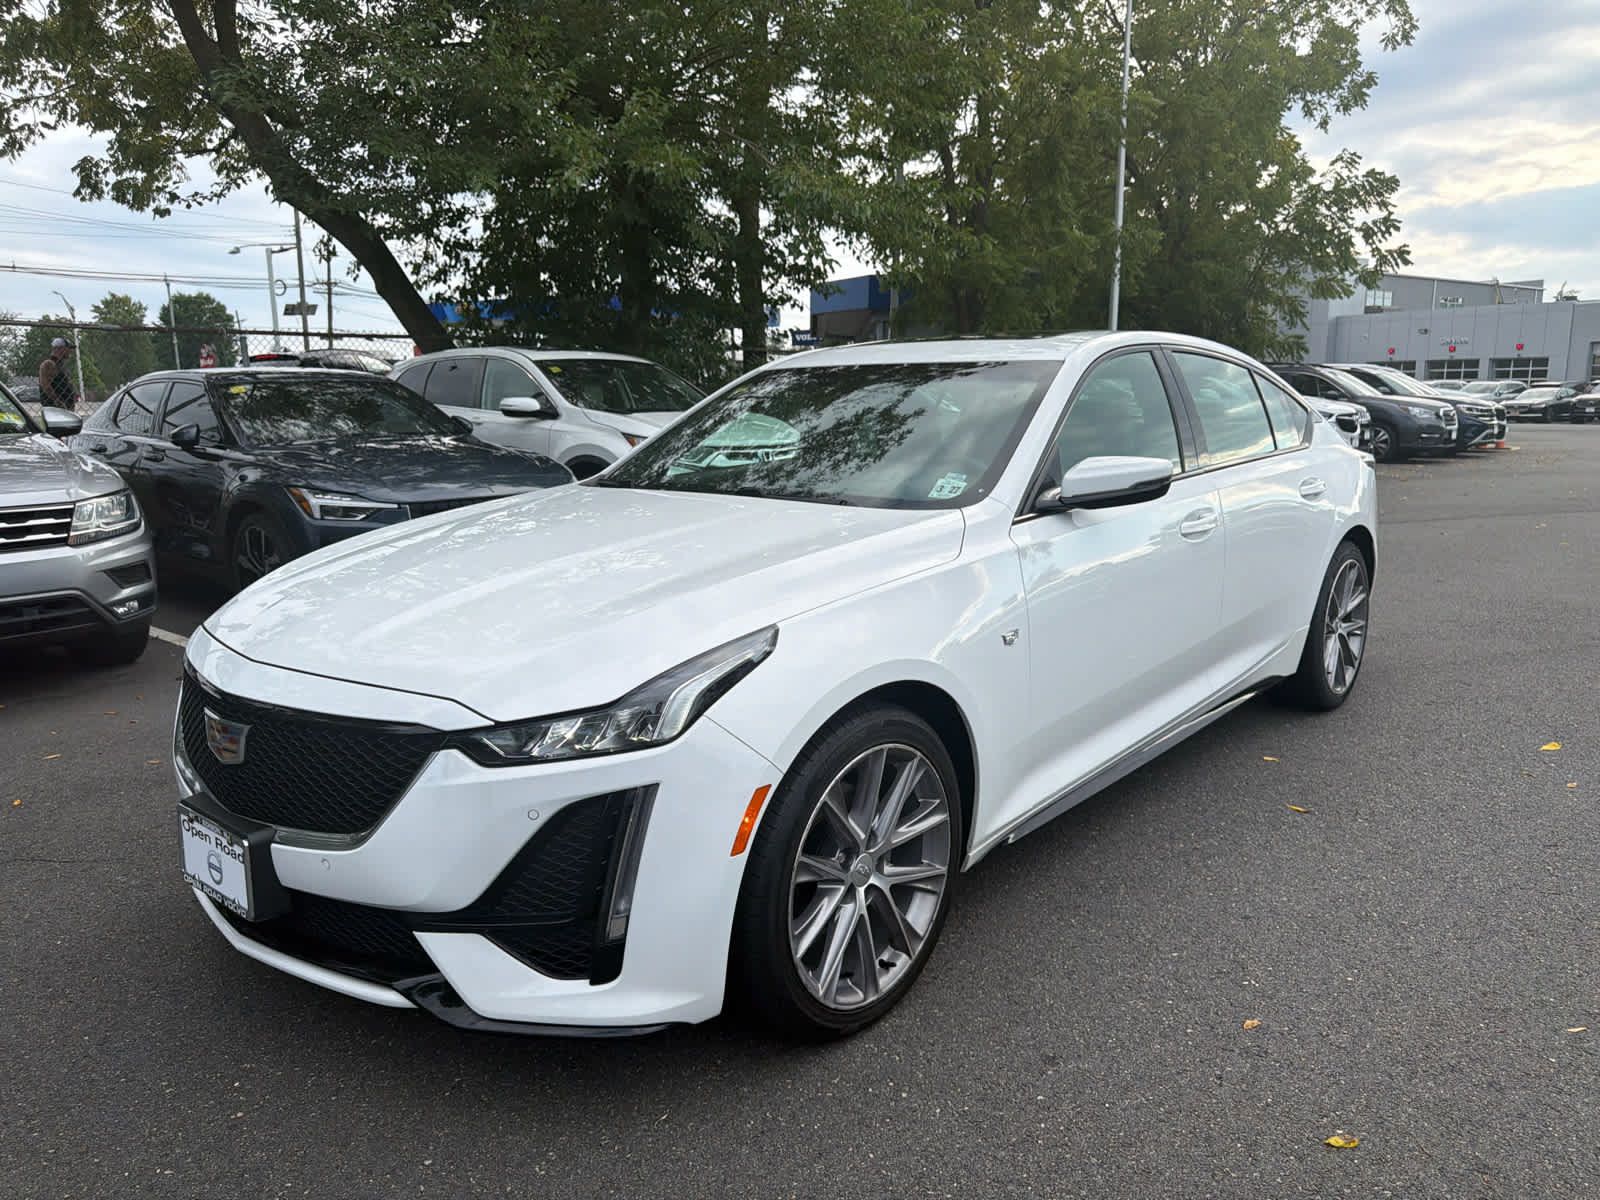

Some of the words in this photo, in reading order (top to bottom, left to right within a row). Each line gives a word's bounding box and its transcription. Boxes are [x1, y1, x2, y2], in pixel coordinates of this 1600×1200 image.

[948, 486, 962, 494] 27
[182, 819, 211, 845] Open
[203, 884, 222, 903] ROAD
